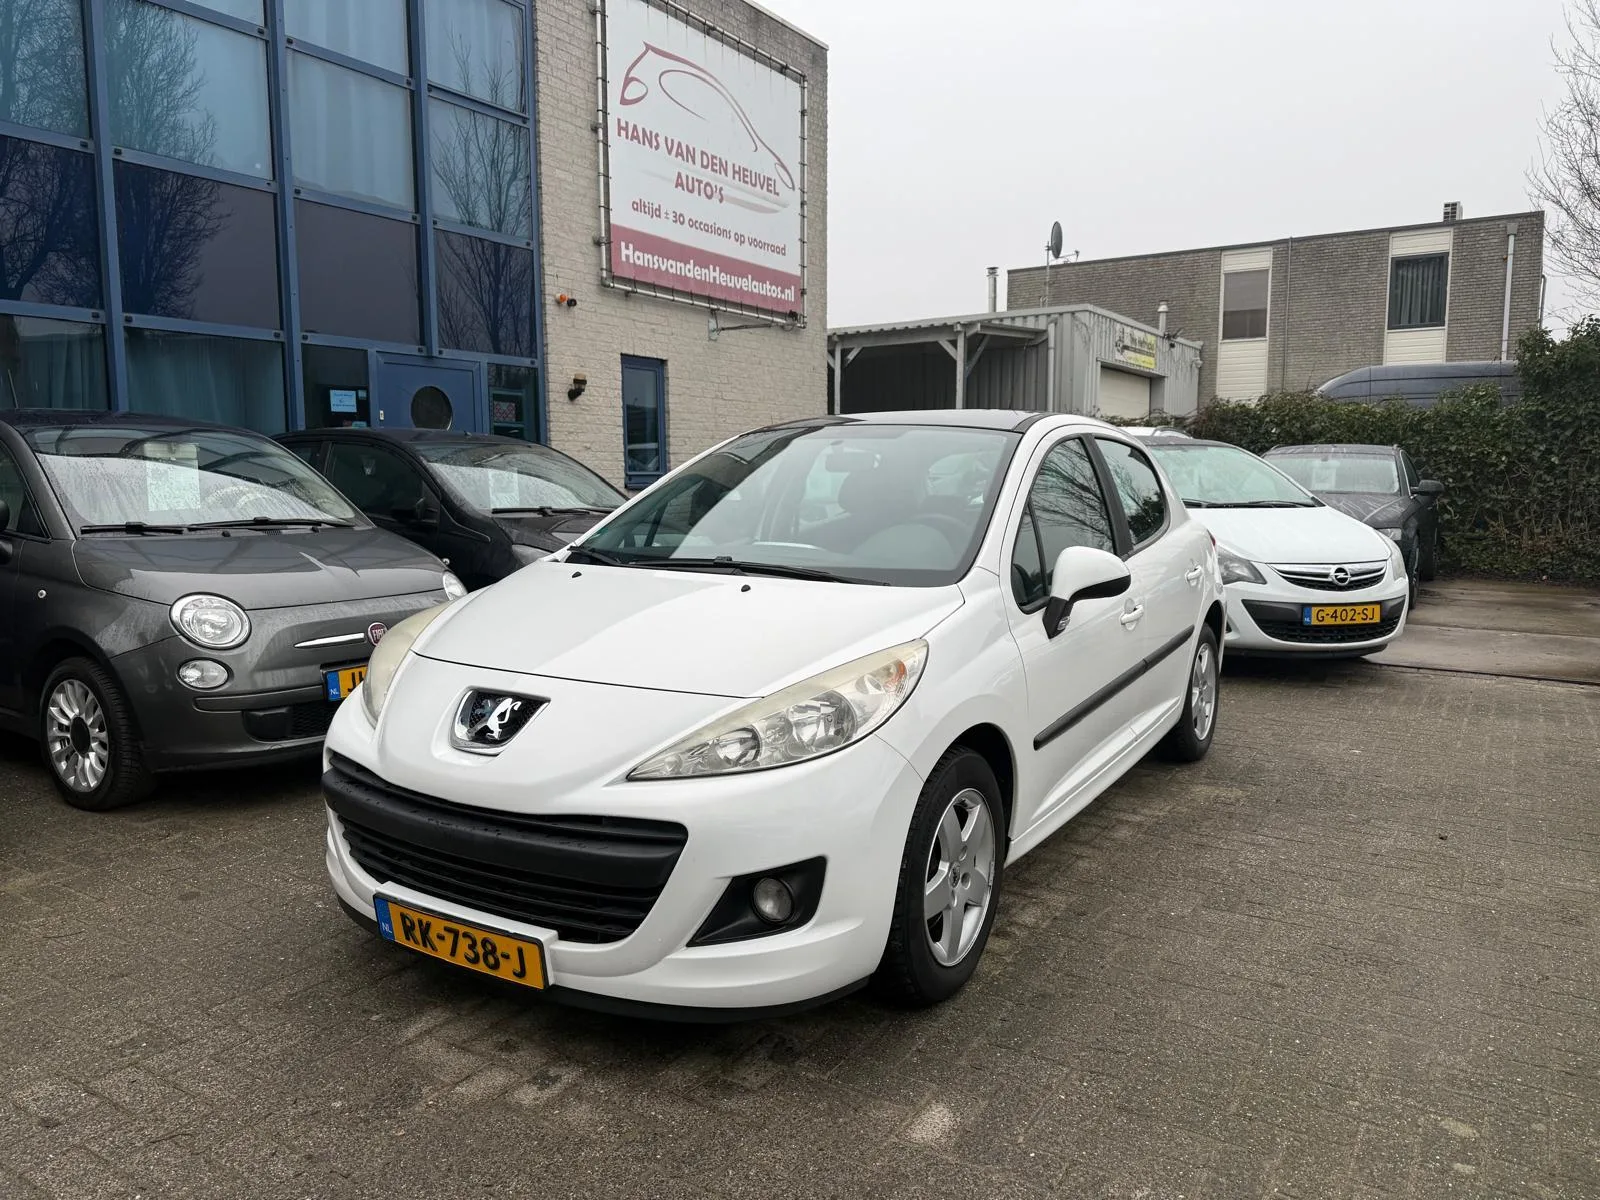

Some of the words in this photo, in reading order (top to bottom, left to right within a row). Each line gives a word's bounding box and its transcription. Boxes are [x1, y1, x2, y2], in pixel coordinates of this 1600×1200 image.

[617, 118, 660, 151] HANS
[664, 135, 696, 165] VAN
[700, 150, 728, 177] DEN
[732, 163, 780, 197] HEUVEL
[674, 171, 724, 204] AUTO'S
[631, 198, 662, 219] altijd
[672, 210, 686, 226] 30
[688, 217, 732, 240] occasions
[733, 231, 746, 246] op
[747, 236, 787, 257] voorraad
[620, 240, 796, 302] HansvandenHeuvelautos.nl
[1316, 608, 1375, 622] G-402-SJ
[382, 921, 392, 934] NL
[400, 912, 526, 978] RK-738-J
